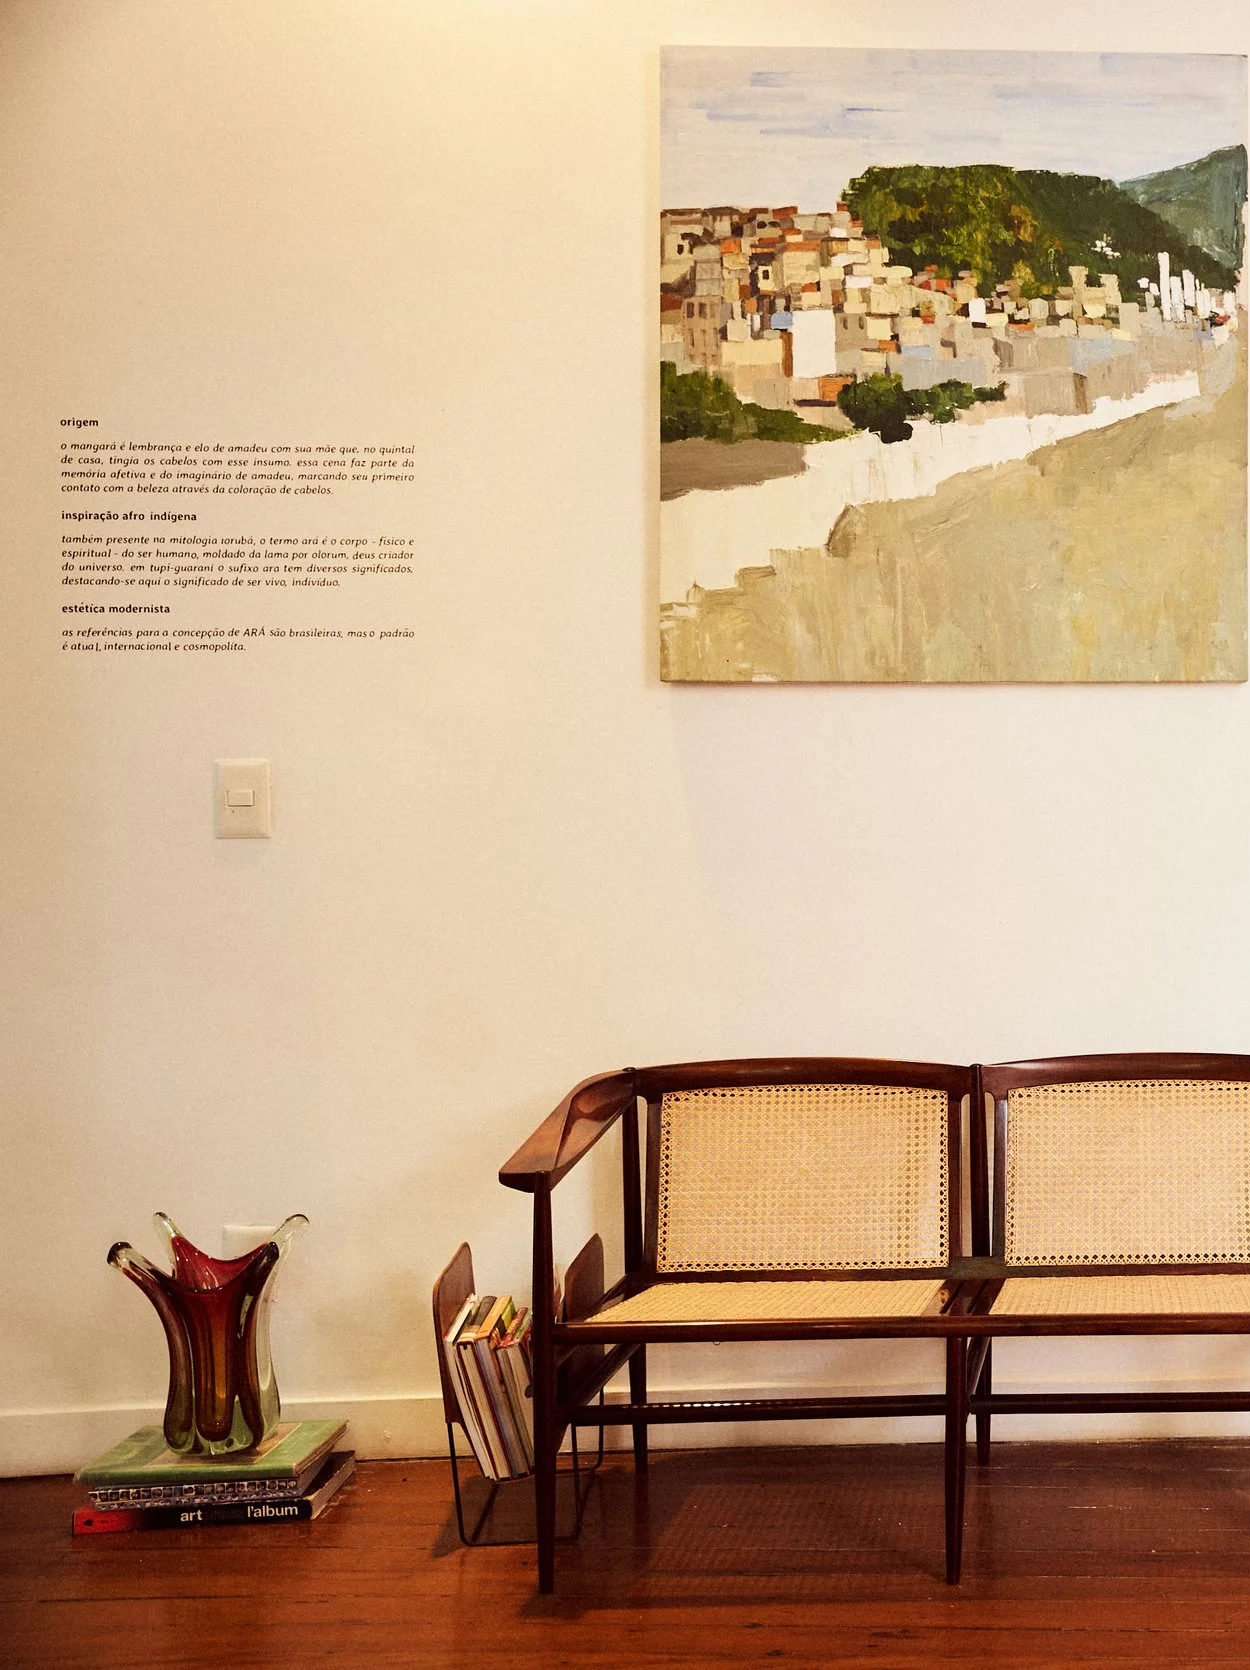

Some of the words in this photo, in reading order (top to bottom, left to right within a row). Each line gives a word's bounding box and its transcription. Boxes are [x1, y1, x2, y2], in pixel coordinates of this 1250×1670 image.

[59, 416, 99, 429] origem
[70, 441, 117, 453] mangará
[119, 441, 126, 451] é
[128, 441, 182, 453] lembrança
[194, 442, 210, 452] elo
[212, 443, 225, 453] de
[227, 443, 268, 453] amadeu
[315, 444, 336, 454] mãe
[363, 446, 376, 454] no
[378, 444, 414, 456] quintal
[60, 454, 74, 464] de
[77, 457, 104, 465] casa,
[109, 455, 139, 468] tingia
[143, 458, 155, 466] os
[159, 455, 198, 466] cabelos
[227, 459, 249, 467] esse
[296, 459, 318, 467] essa
[350, 457, 366, 468] faz
[370, 459, 398, 470] parte
[401, 458, 414, 468] da
[61, 468, 106, 478] memória
[109, 468, 146, 480] afetiva
[149, 472, 156, 480] e
[159, 469, 173, 479] do
[176, 470, 232, 483] imaginário
[235, 471, 248, 480] de
[297, 471, 348, 481] marcando
[371, 472, 415, 483] primeiro
[60, 483, 101, 493] contato
[103, 485, 124, 493] com
[136, 483, 169, 493] beleza
[171, 484, 210, 493] através
[212, 484, 225, 494] da
[227, 484, 277, 496] coloração
[279, 484, 292, 494] de
[61, 510, 120, 522] inspiração
[122, 510, 145, 521] afro
[150, 510, 197, 523] indígena
[61, 533, 103, 544] também
[105, 535, 150, 546] presente
[153, 536, 166, 544] na
[169, 535, 218, 548] mitologia
[269, 536, 299, 545] termo
[321, 536, 328, 545] é
[330, 538, 337, 546] o
[339, 538, 368, 548] corpo
[61, 548, 112, 560] espiritual
[121, 548, 135, 558] do
[137, 550, 153, 558] ser
[155, 548, 199, 560] humano,
[202, 548, 246, 559] moldado
[248, 549, 261, 558] da
[264, 549, 289, 559] lama
[291, 552, 308, 561] por
[352, 550, 375, 560] deus
[378, 550, 414, 560] criador
[61, 561, 75, 571] do
[130, 564, 145, 572] em
[217, 564, 225, 572] o
[228, 562, 259, 573] sufixo
[283, 564, 303, 573] tem
[306, 563, 348, 573] diversos
[61, 575, 136, 586] destacando-se
[163, 578, 171, 586] o
[173, 576, 229, 589] significado
[231, 576, 244, 586] de
[247, 579, 261, 587] ser
[61, 601, 105, 614] estética
[108, 603, 171, 614] modernista
[61, 629, 74, 637] as
[76, 627, 133, 638] referências
[135, 630, 160, 639] para
[161, 629, 169, 637] a
[172, 627, 225, 639] concepção
[227, 627, 240, 637] de
[242, 627, 265, 637] ARÁ
[269, 627, 286, 638] são
[347, 630, 367, 638] mas
[368, 630, 375, 638] o
[379, 627, 415, 640] padrão
[61, 641, 68, 651] é
[103, 641, 172, 651] internacional
[180, 1509, 203, 1523] art
